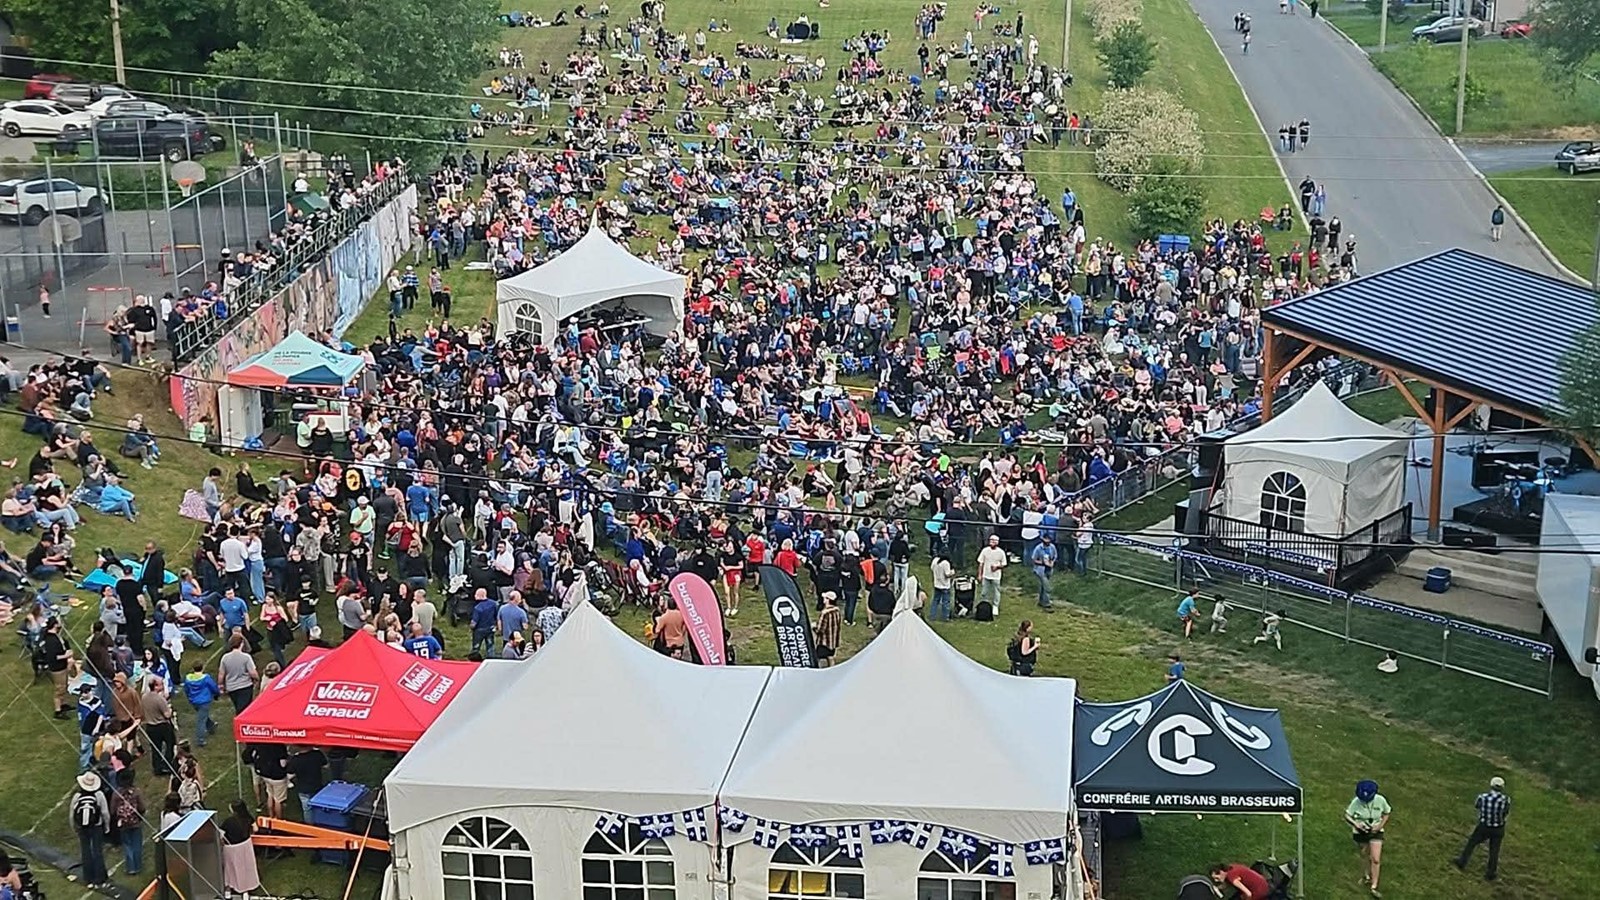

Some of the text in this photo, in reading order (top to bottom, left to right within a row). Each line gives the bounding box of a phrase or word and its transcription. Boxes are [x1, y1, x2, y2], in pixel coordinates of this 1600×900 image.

[414, 648, 429, 660] 19
[403, 667, 433, 692] Voisin
[317, 682, 372, 703] Voisin
[423, 675, 455, 704] Renaud
[304, 704, 371, 719] Renaud
[242, 725, 306, 737] Voisin Renaud
[1083, 792, 1296, 807] CONFRÉRIE ARTISANS BRASSEURS
